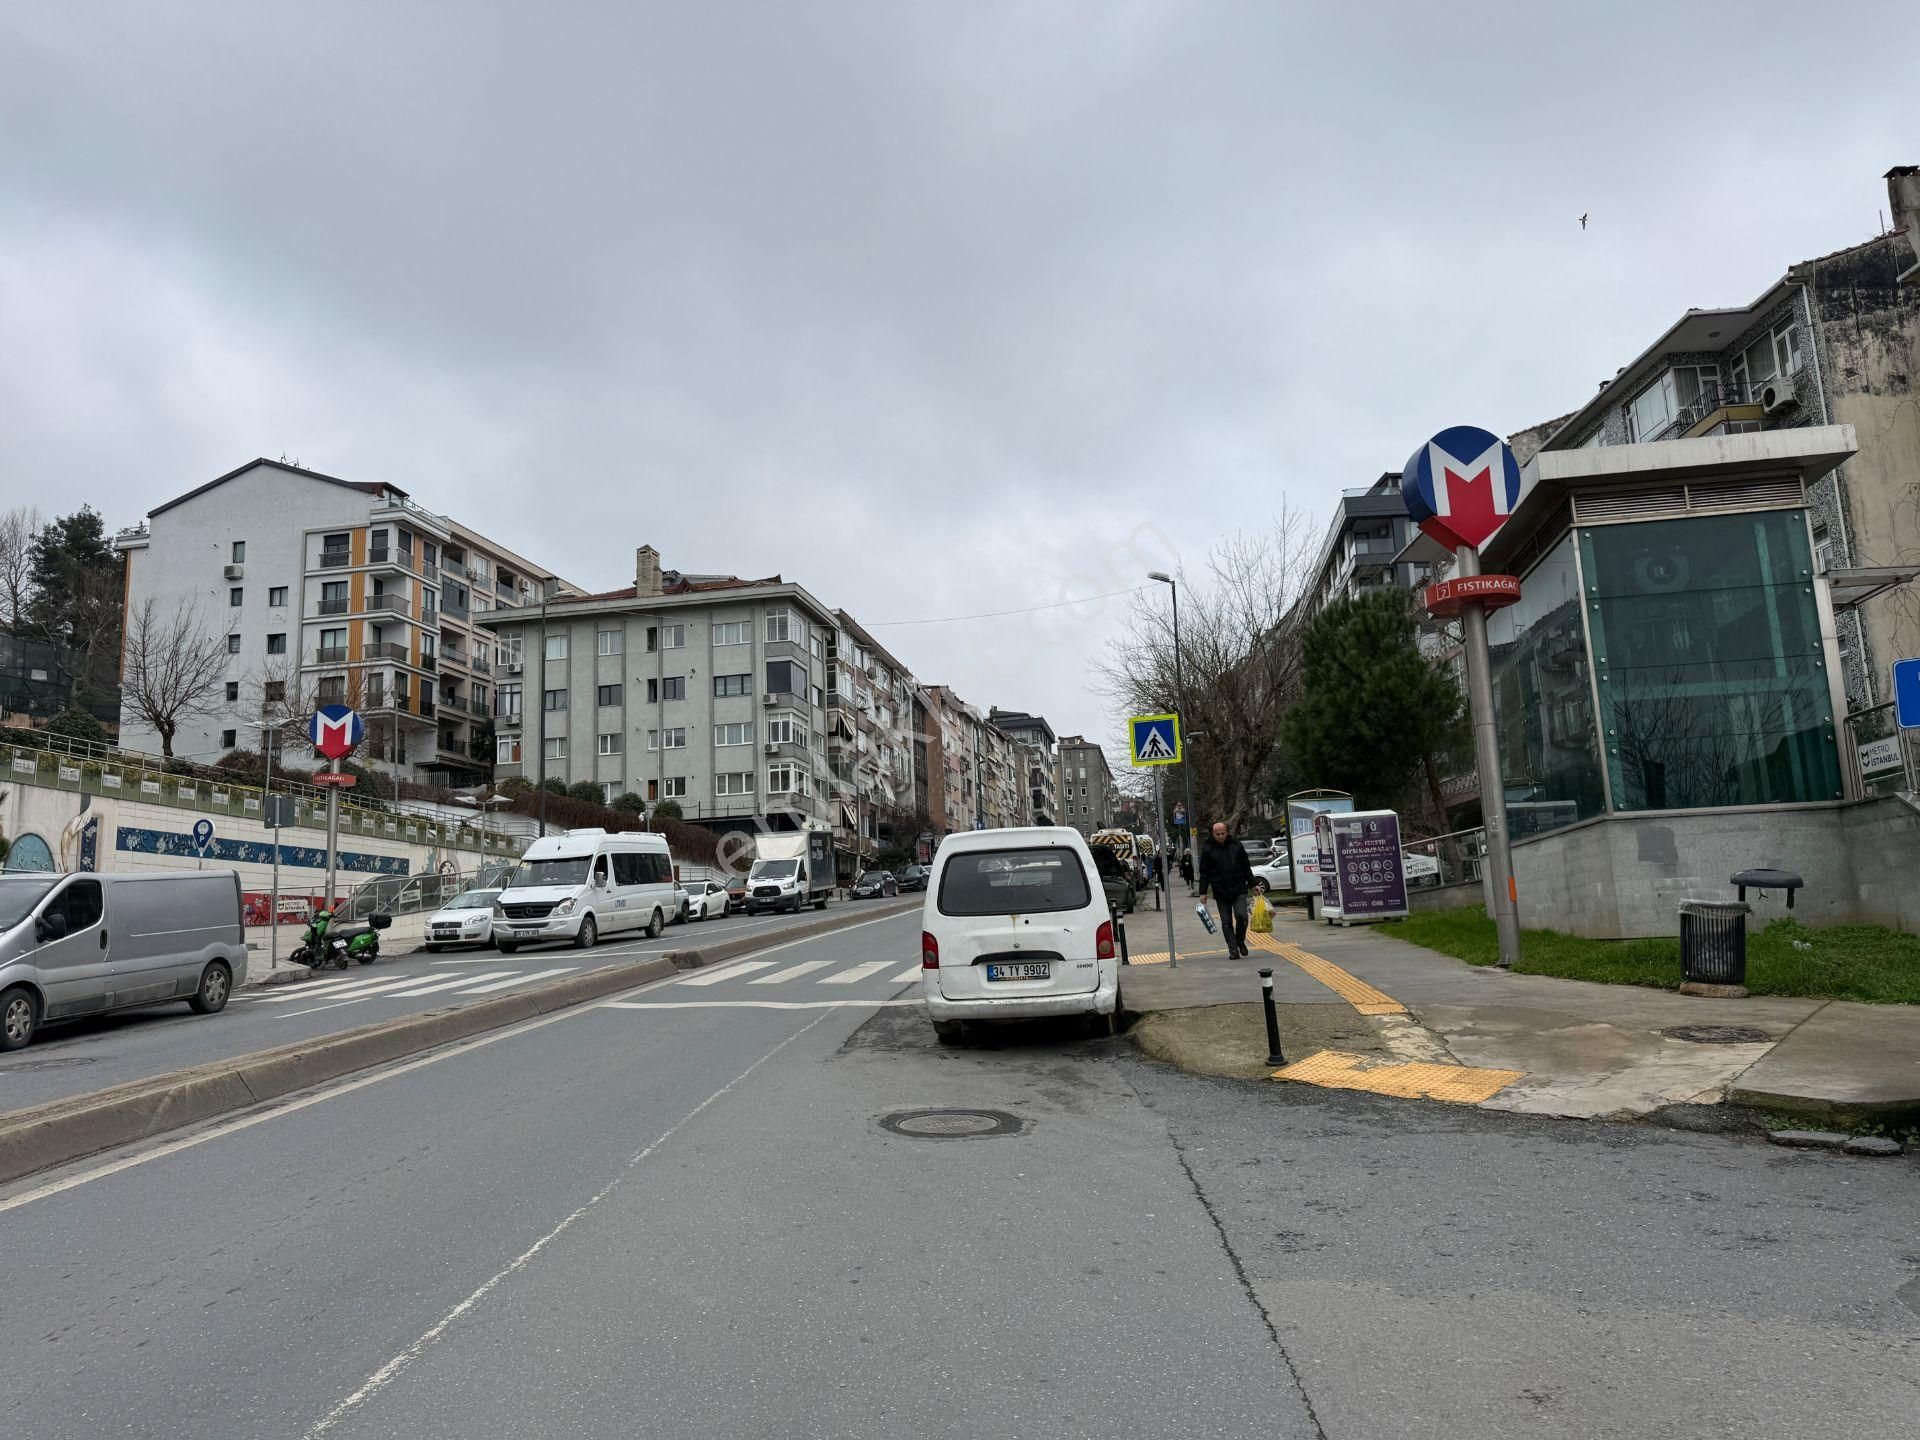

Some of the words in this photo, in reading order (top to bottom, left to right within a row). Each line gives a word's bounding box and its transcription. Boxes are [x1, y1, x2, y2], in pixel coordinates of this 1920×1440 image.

[1869, 743, 1889, 756] METRO
[1871, 752, 1899, 766] İSTANBUL
[993, 966, 1005, 977] 34
[1009, 965, 1020, 976] TY
[1023, 964, 1048, 976] 9902
